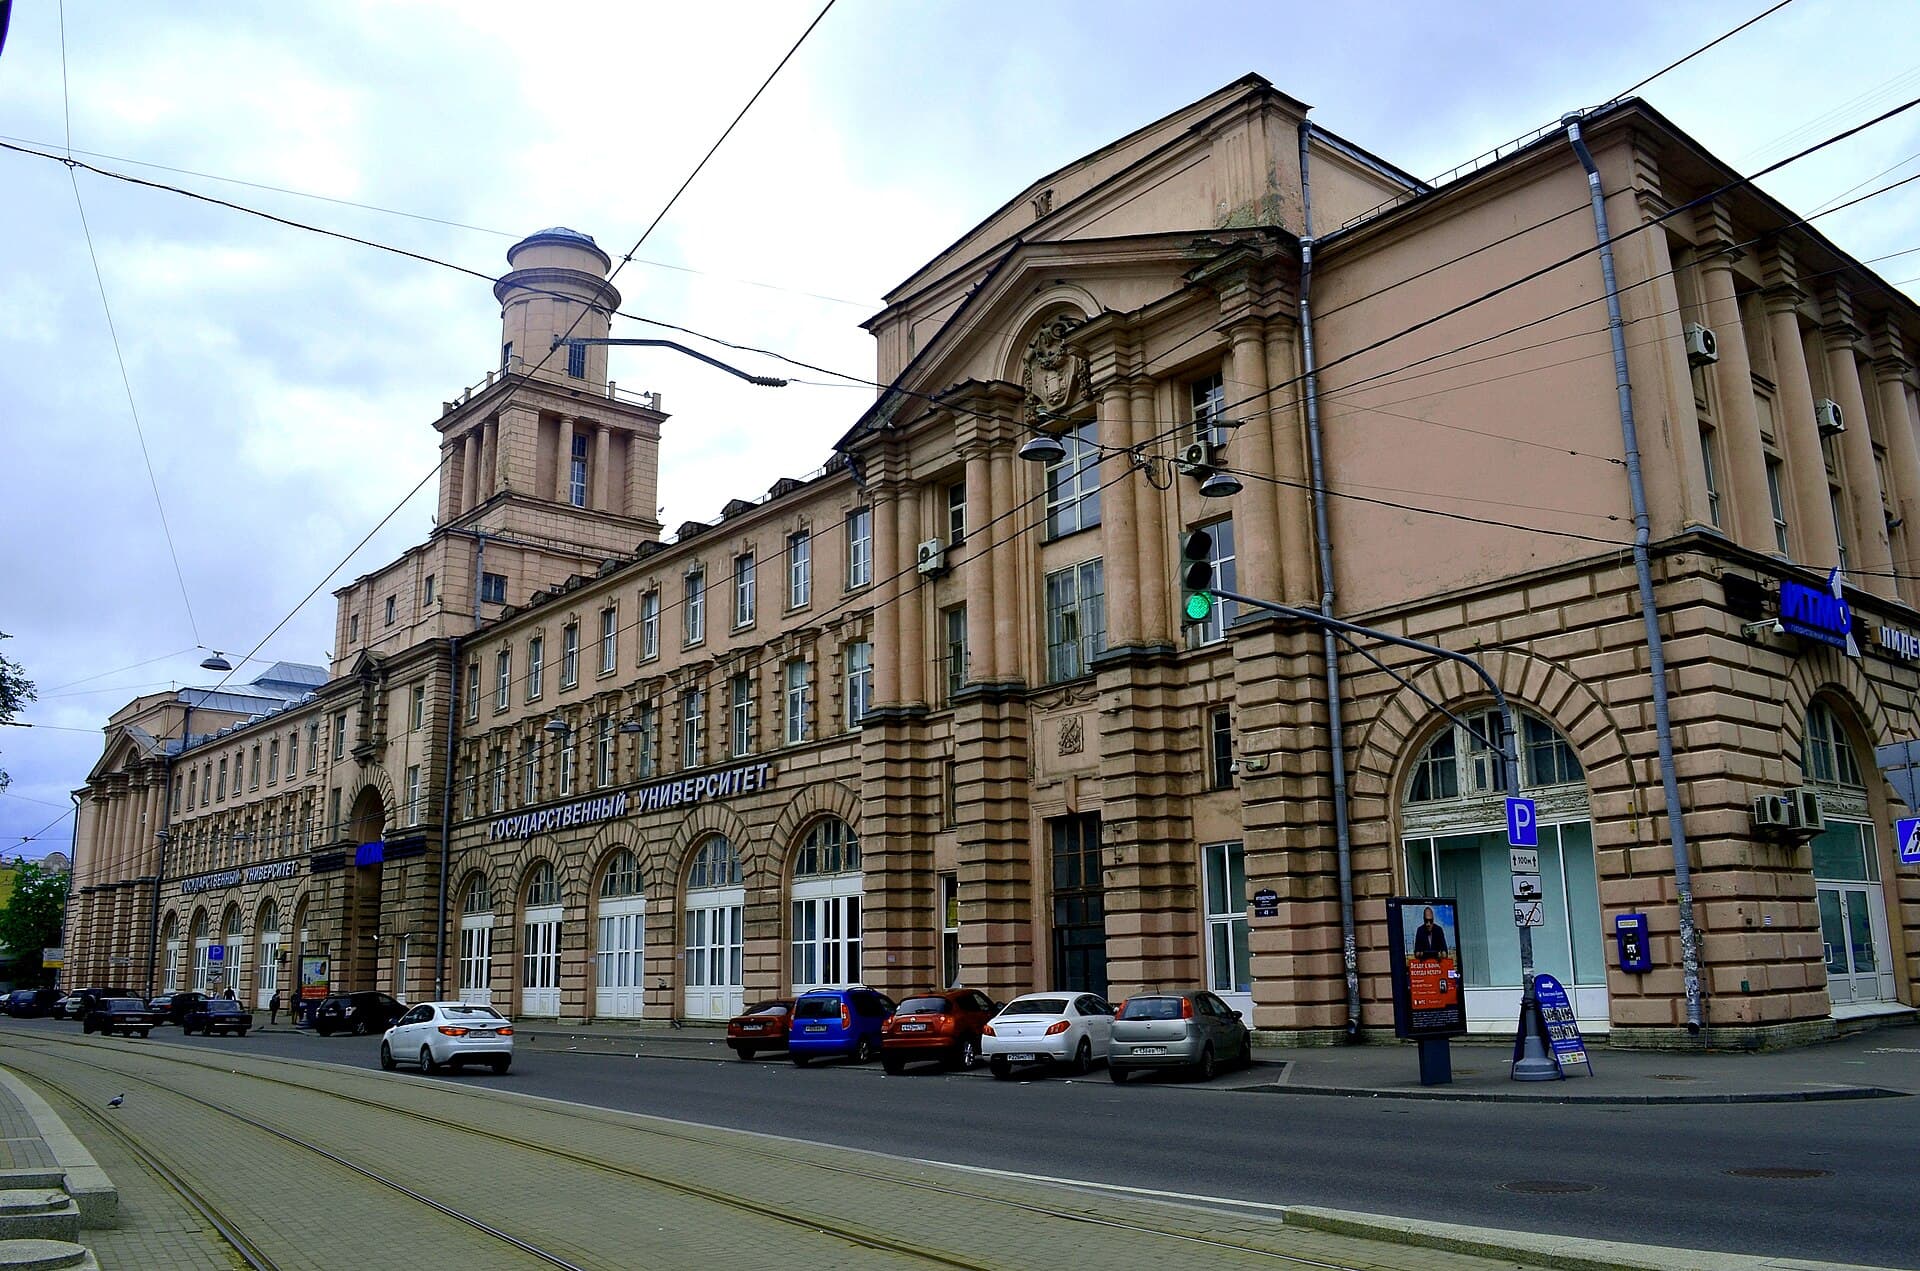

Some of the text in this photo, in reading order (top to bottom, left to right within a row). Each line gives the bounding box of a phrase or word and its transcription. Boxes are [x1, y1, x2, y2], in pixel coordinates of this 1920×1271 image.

[1780, 579, 1852, 635] ИТМО
[1880, 625, 1920, 661] ЛИДЕ
[488, 763, 769, 841] ГОСУДАРСТВЕННЫЙ УНИВЕРСИТЕТ
[182, 860, 297, 894] ГОСУДАРСТВЕННЫЙ УНИВЕРСИТЕТ
